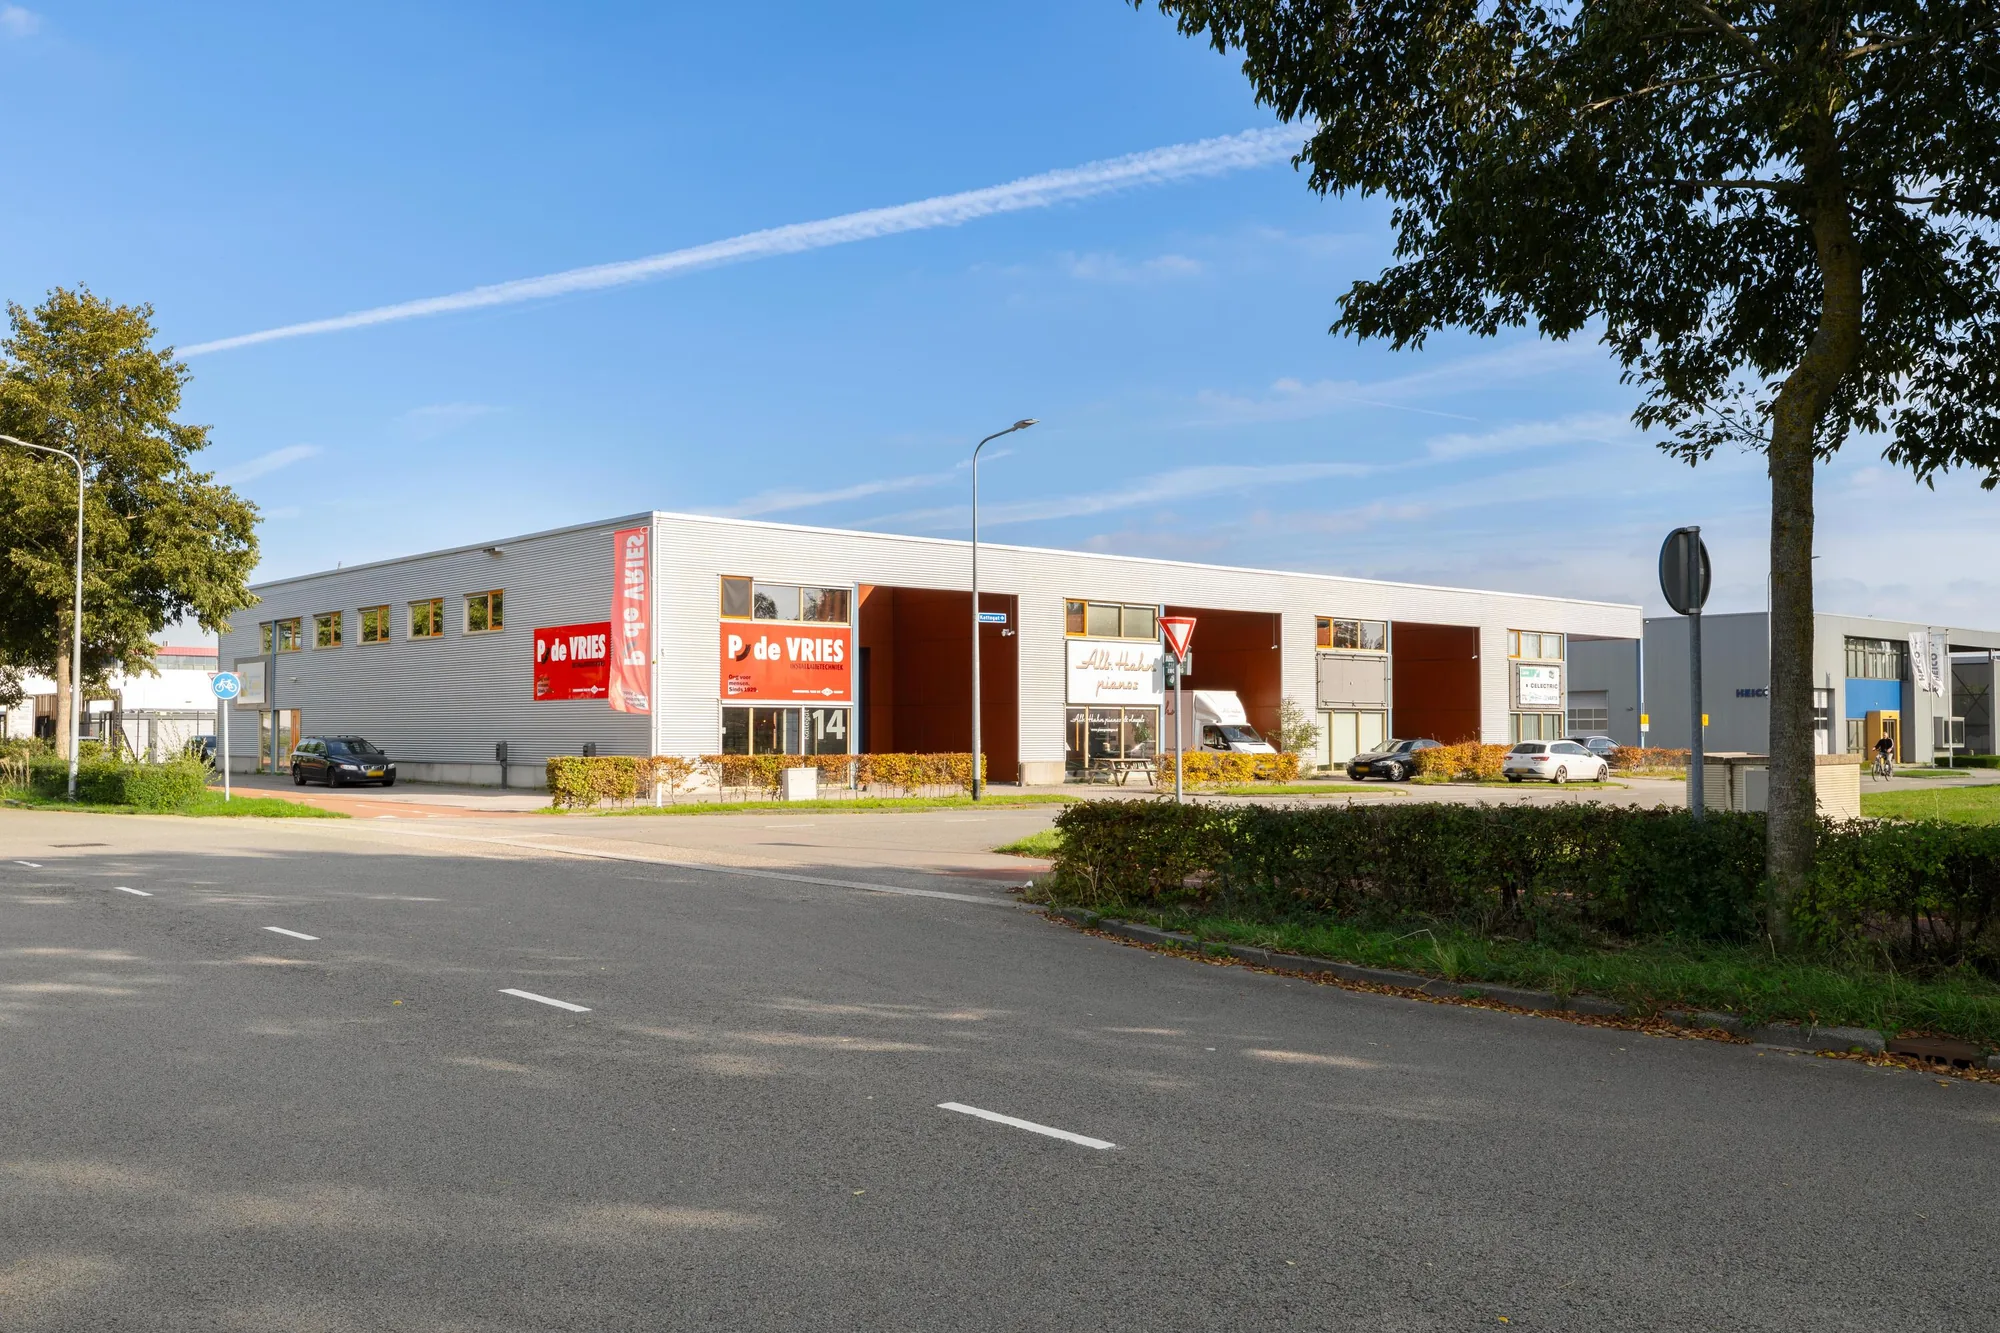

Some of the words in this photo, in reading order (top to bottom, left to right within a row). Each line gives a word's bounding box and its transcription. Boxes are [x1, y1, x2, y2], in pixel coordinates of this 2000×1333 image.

[550, 637, 567, 662] de
[569, 633, 606, 660] VRIES
[753, 635, 781, 661] de
[785, 637, 844, 663] VRIES
[812, 709, 846, 740] 14
